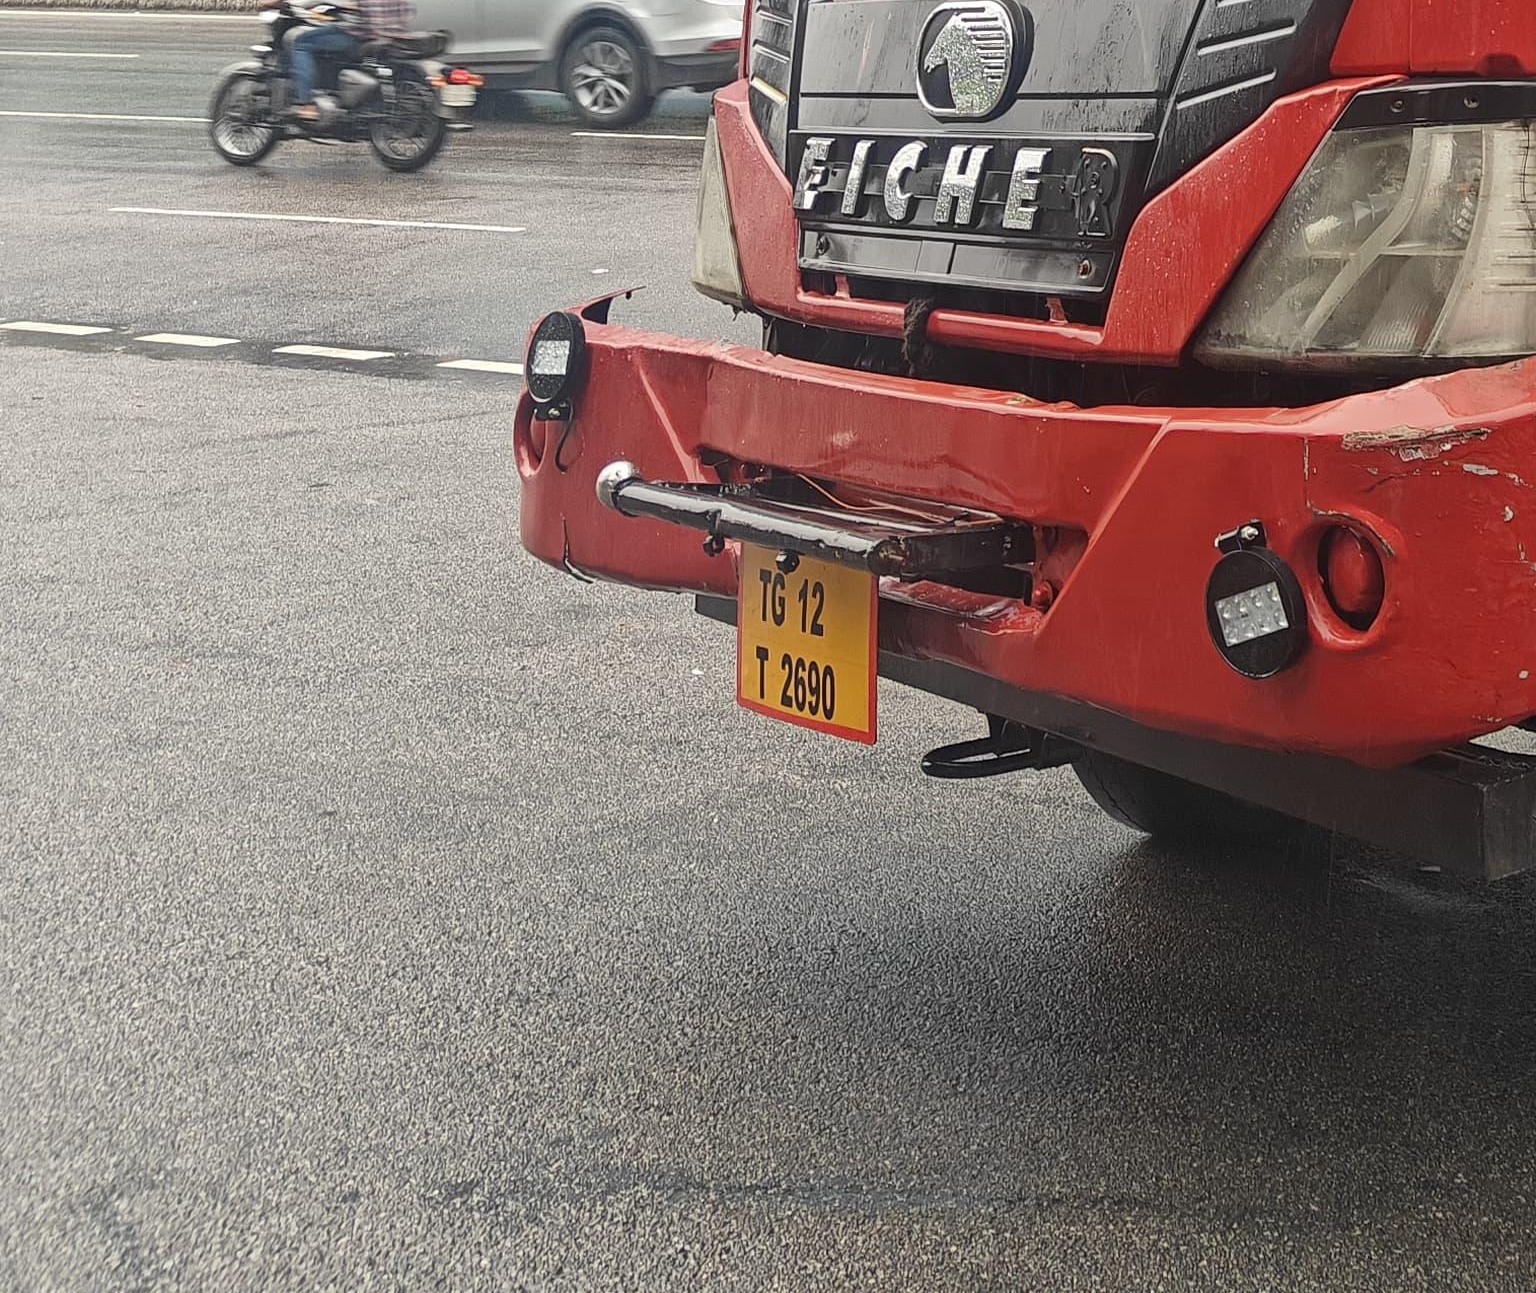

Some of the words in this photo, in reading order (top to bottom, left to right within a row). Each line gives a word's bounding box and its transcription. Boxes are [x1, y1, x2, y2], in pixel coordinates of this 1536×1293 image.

[759, 568, 786, 627] TG
[798, 579, 824, 637] 12
[756, 645, 769, 700] T
[781, 653, 835, 720] 2690
